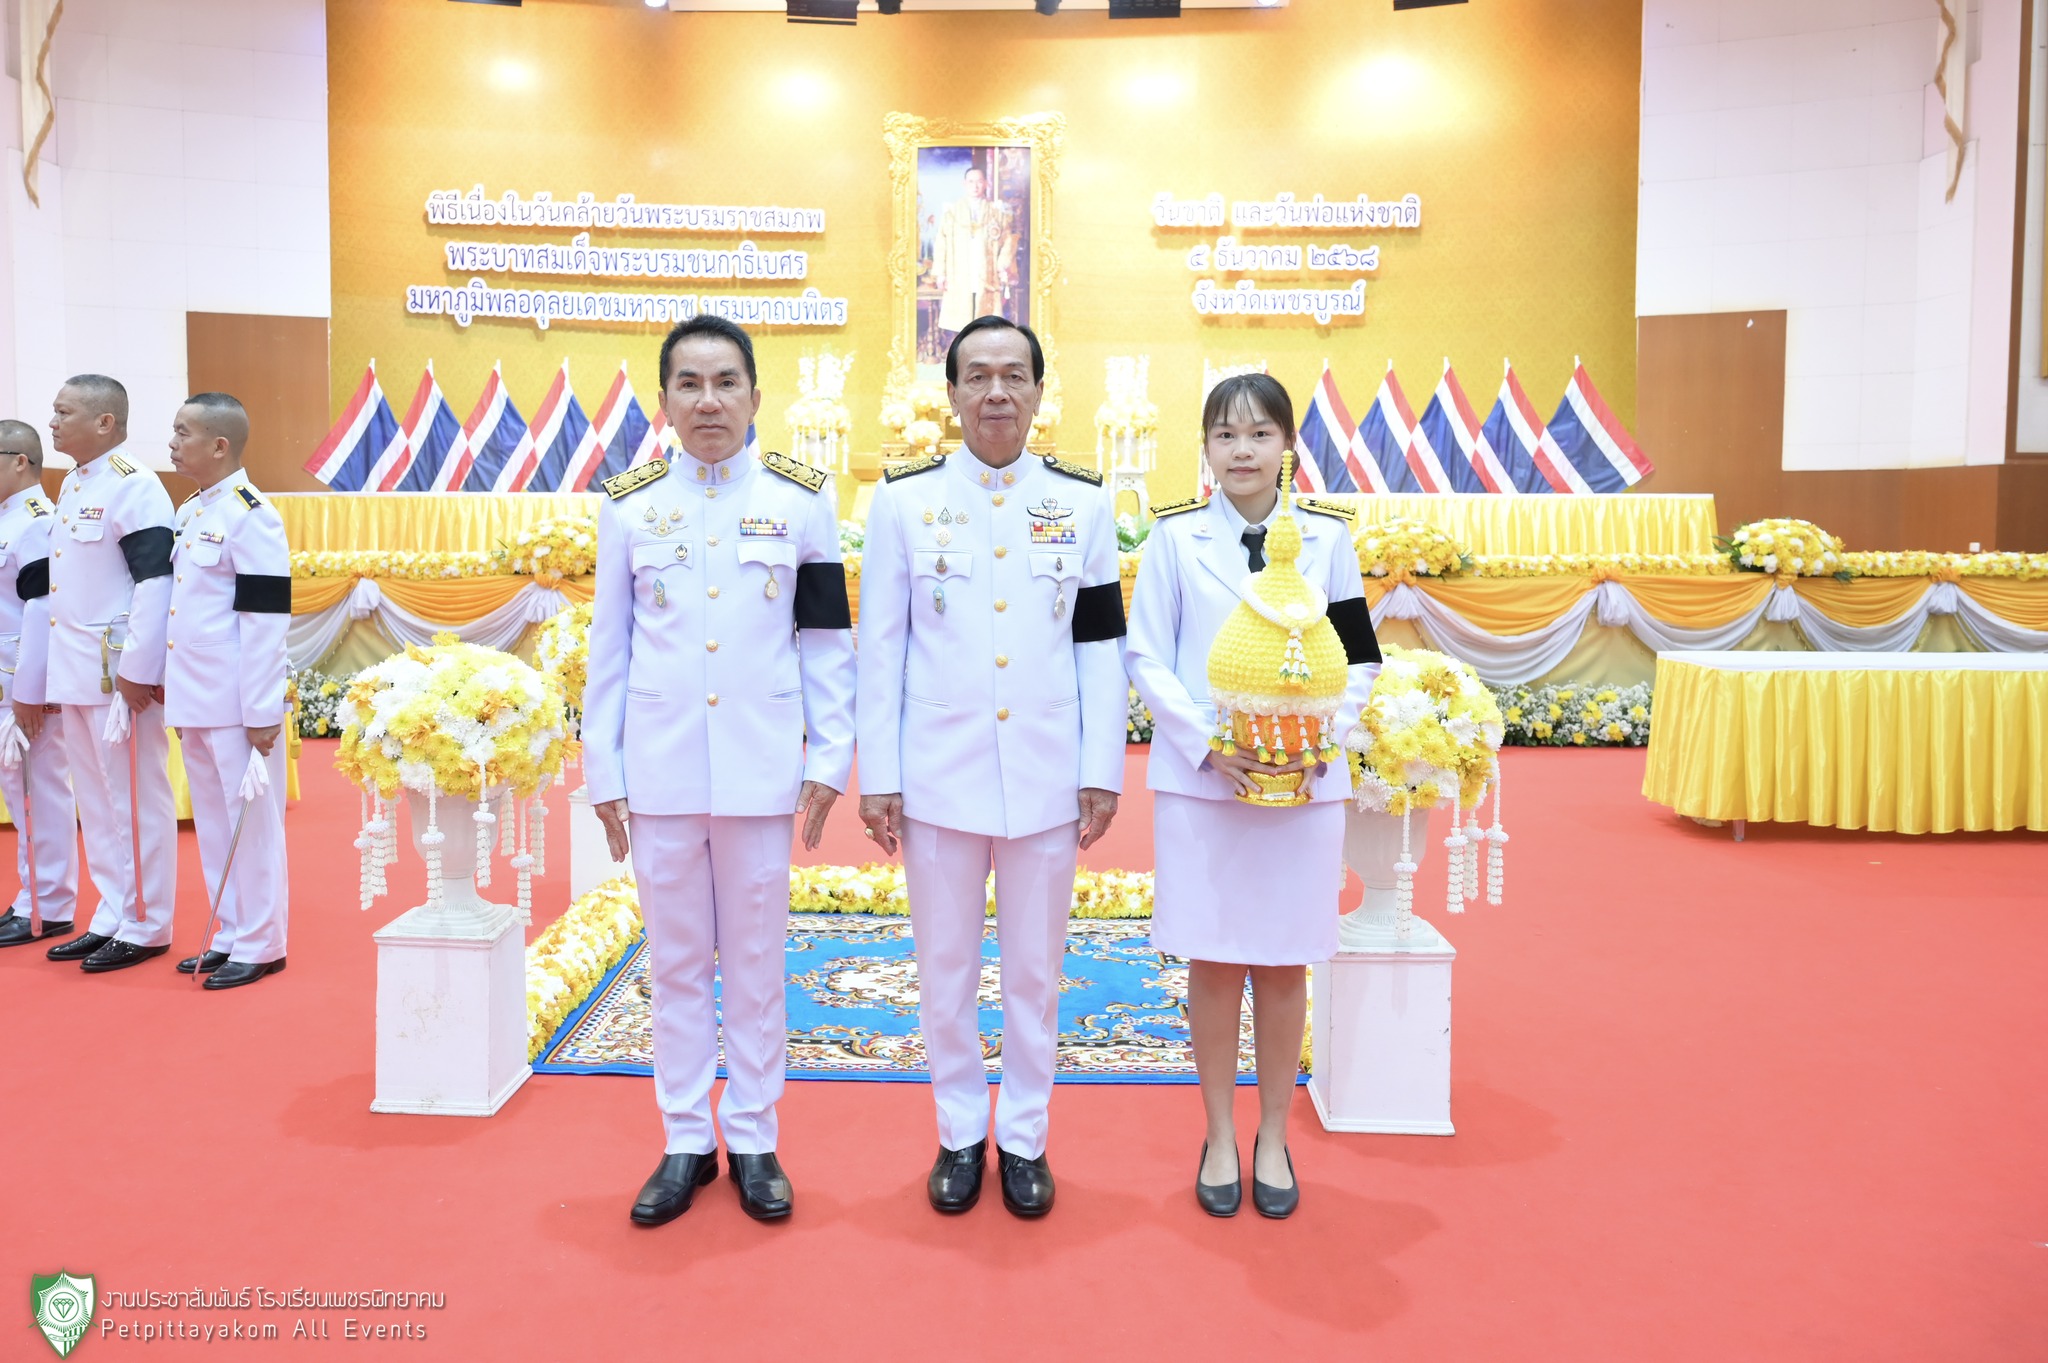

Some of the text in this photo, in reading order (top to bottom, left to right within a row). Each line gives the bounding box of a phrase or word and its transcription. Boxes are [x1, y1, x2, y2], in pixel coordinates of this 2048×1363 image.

[428, 187, 822, 229] พิธีเนื่องในวันคล้ายวันพระบรมราชสมภพ
[1234, 196, 1419, 224] และวันพ่อแห่งชาติ
[448, 236, 805, 276] พระบาทสมเด็จพระบรมชนกาธิเบศร
[1217, 240, 1298, 268] ธันวาคม
[1310, 247, 1377, 267] ๒๕๖๘
[409, 280, 695, 326] มหาภูมิพลอดุลยเดชมหาราช
[1194, 283, 1364, 321] จังหวัดเพชรบูรณ์
